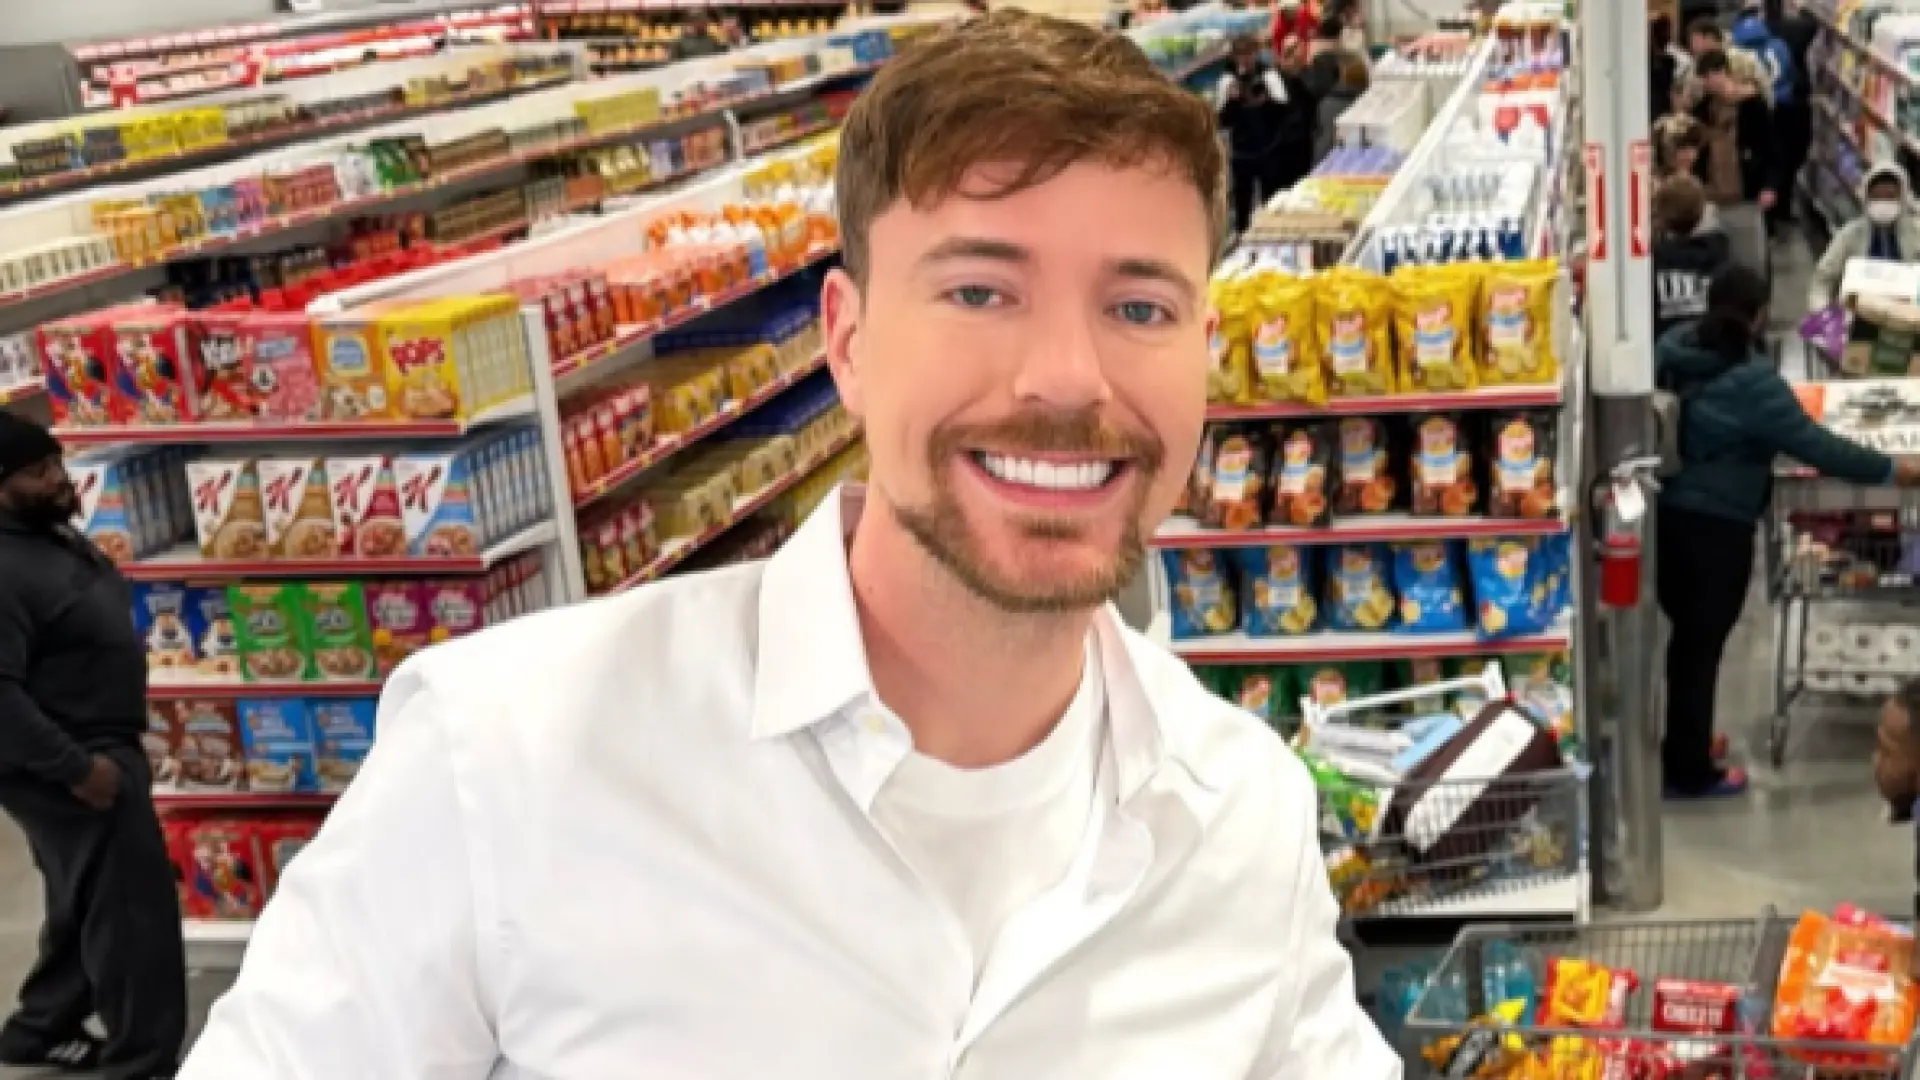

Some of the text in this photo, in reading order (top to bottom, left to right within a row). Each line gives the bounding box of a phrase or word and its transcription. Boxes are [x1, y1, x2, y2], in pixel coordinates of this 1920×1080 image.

[195, 470, 232, 515] K
[266, 466, 303, 511] K
[334, 464, 373, 511] K
[402, 464, 441, 512] K
